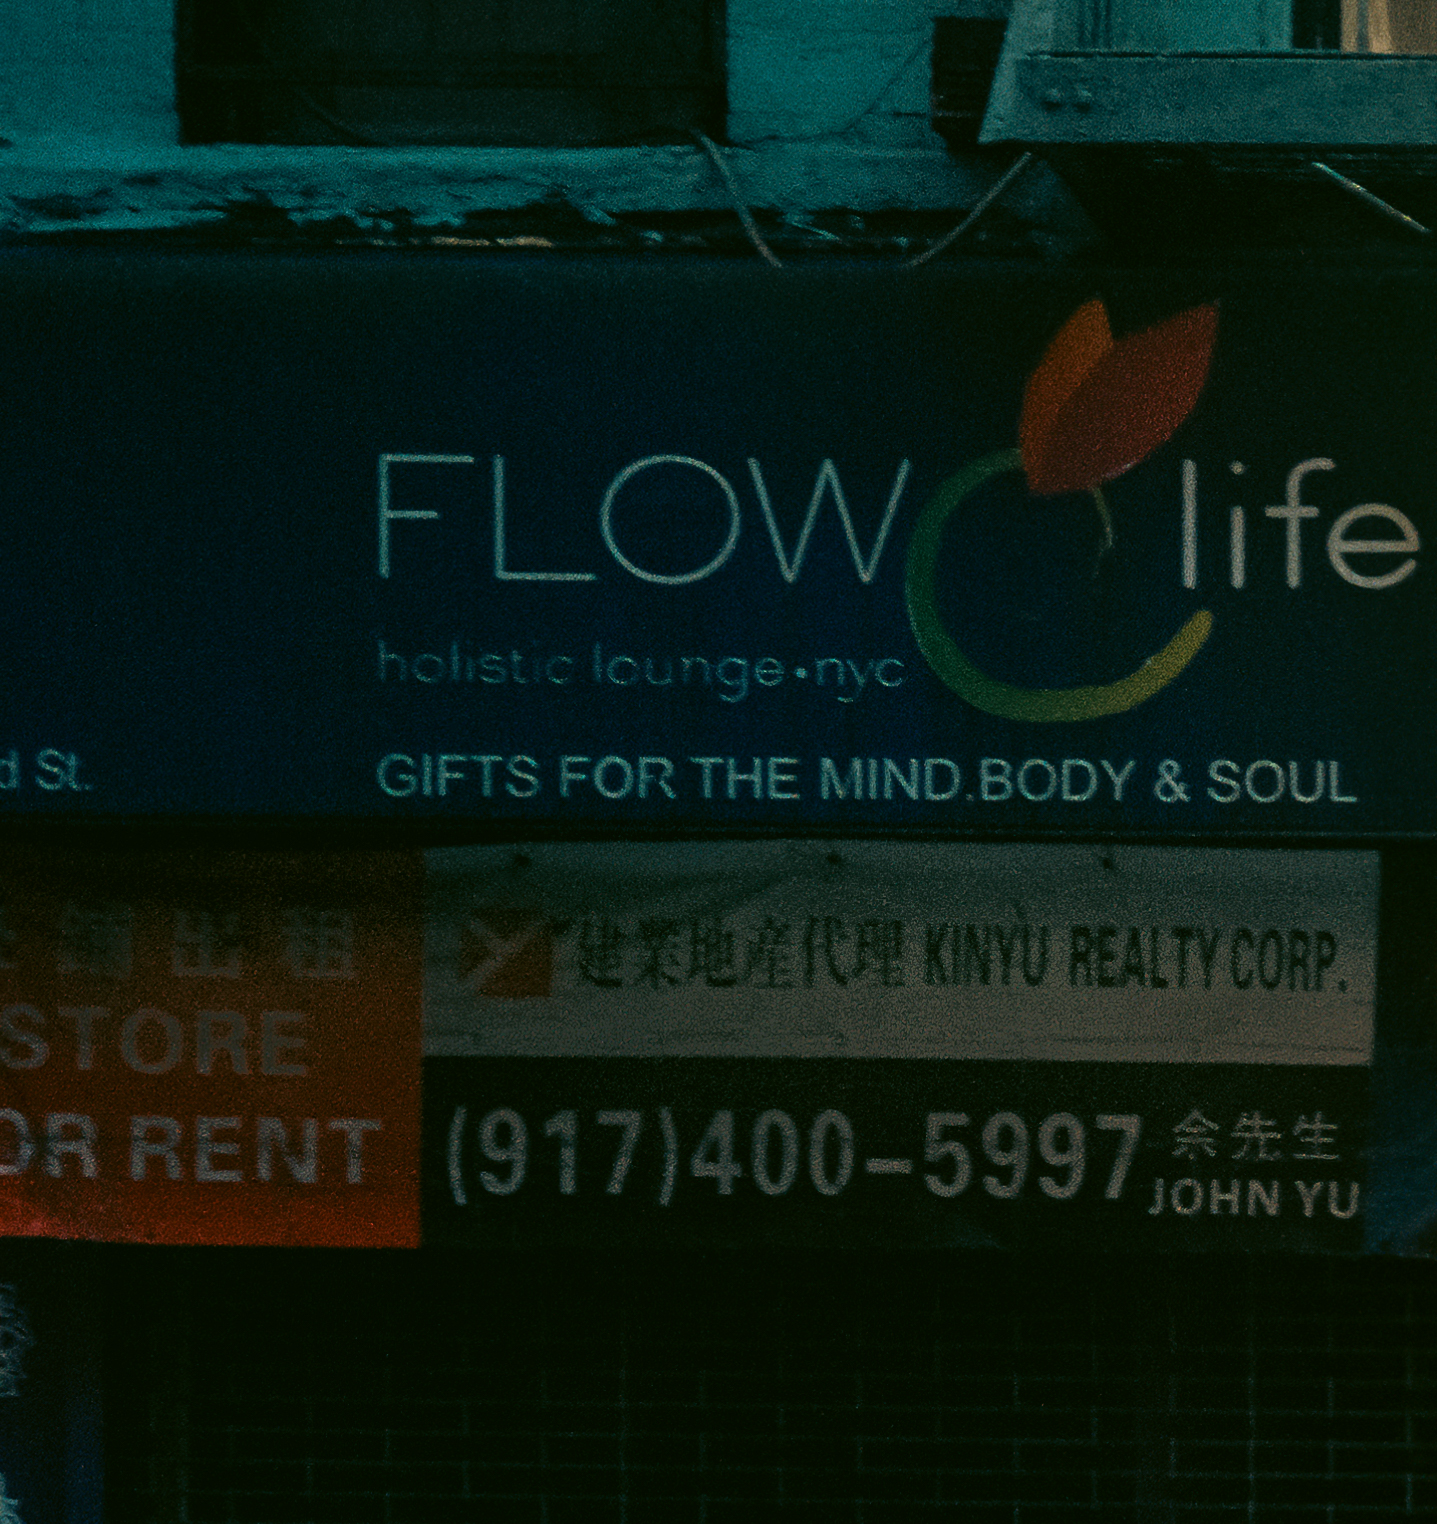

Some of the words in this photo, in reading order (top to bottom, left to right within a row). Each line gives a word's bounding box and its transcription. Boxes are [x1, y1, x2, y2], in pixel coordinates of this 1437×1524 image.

[379, 454, 913, 585] FLOW
[1180, 456, 1422, 590] life
[376, 639, 575, 685] holistic
[35, 748, 92, 791] St.
[376, 753, 541, 798] GIFTS
[560, 755, 677, 800] FOR
[689, 756, 801, 801] THE
[1153, 759, 1191, 803] &
[1206, 760, 1359, 803] SOUL
[925, 922, 1049, 989] KINYU
[1068, 925, 1222, 990] REALTY
[1230, 928, 1348, 995] CORP.
[0, 1002, 310, 1077] STORE
[129, 1113, 385, 1186] RENT
[447, 1104, 1143, 1207] (917)400-5997
[1148, 1176, 1282, 1217] JOHN
[1294, 1178, 1361, 1220] YU
